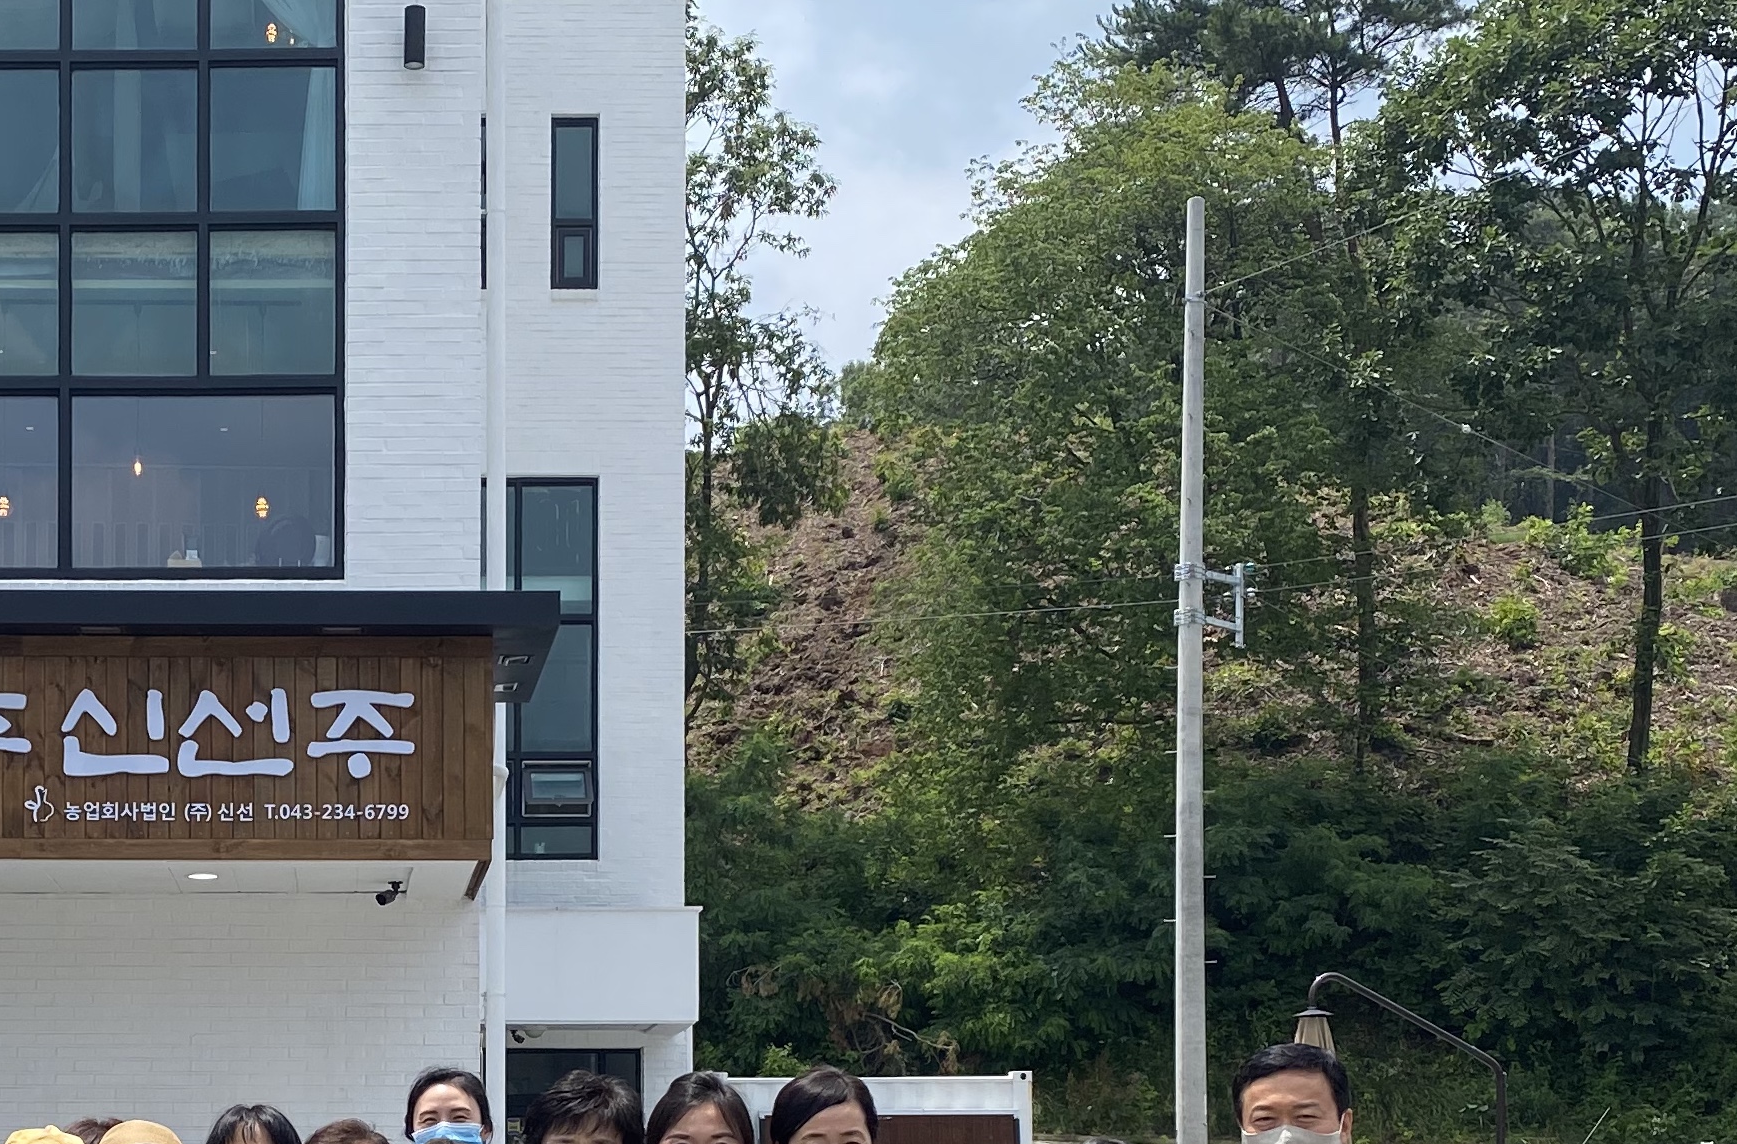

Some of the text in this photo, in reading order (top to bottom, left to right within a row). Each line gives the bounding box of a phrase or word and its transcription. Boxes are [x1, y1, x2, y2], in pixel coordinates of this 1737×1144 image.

[61, 687, 415, 779] 신선주
[63, 801, 410, 823] 농업회사법인 (주) 신선 T.043-234-6799
